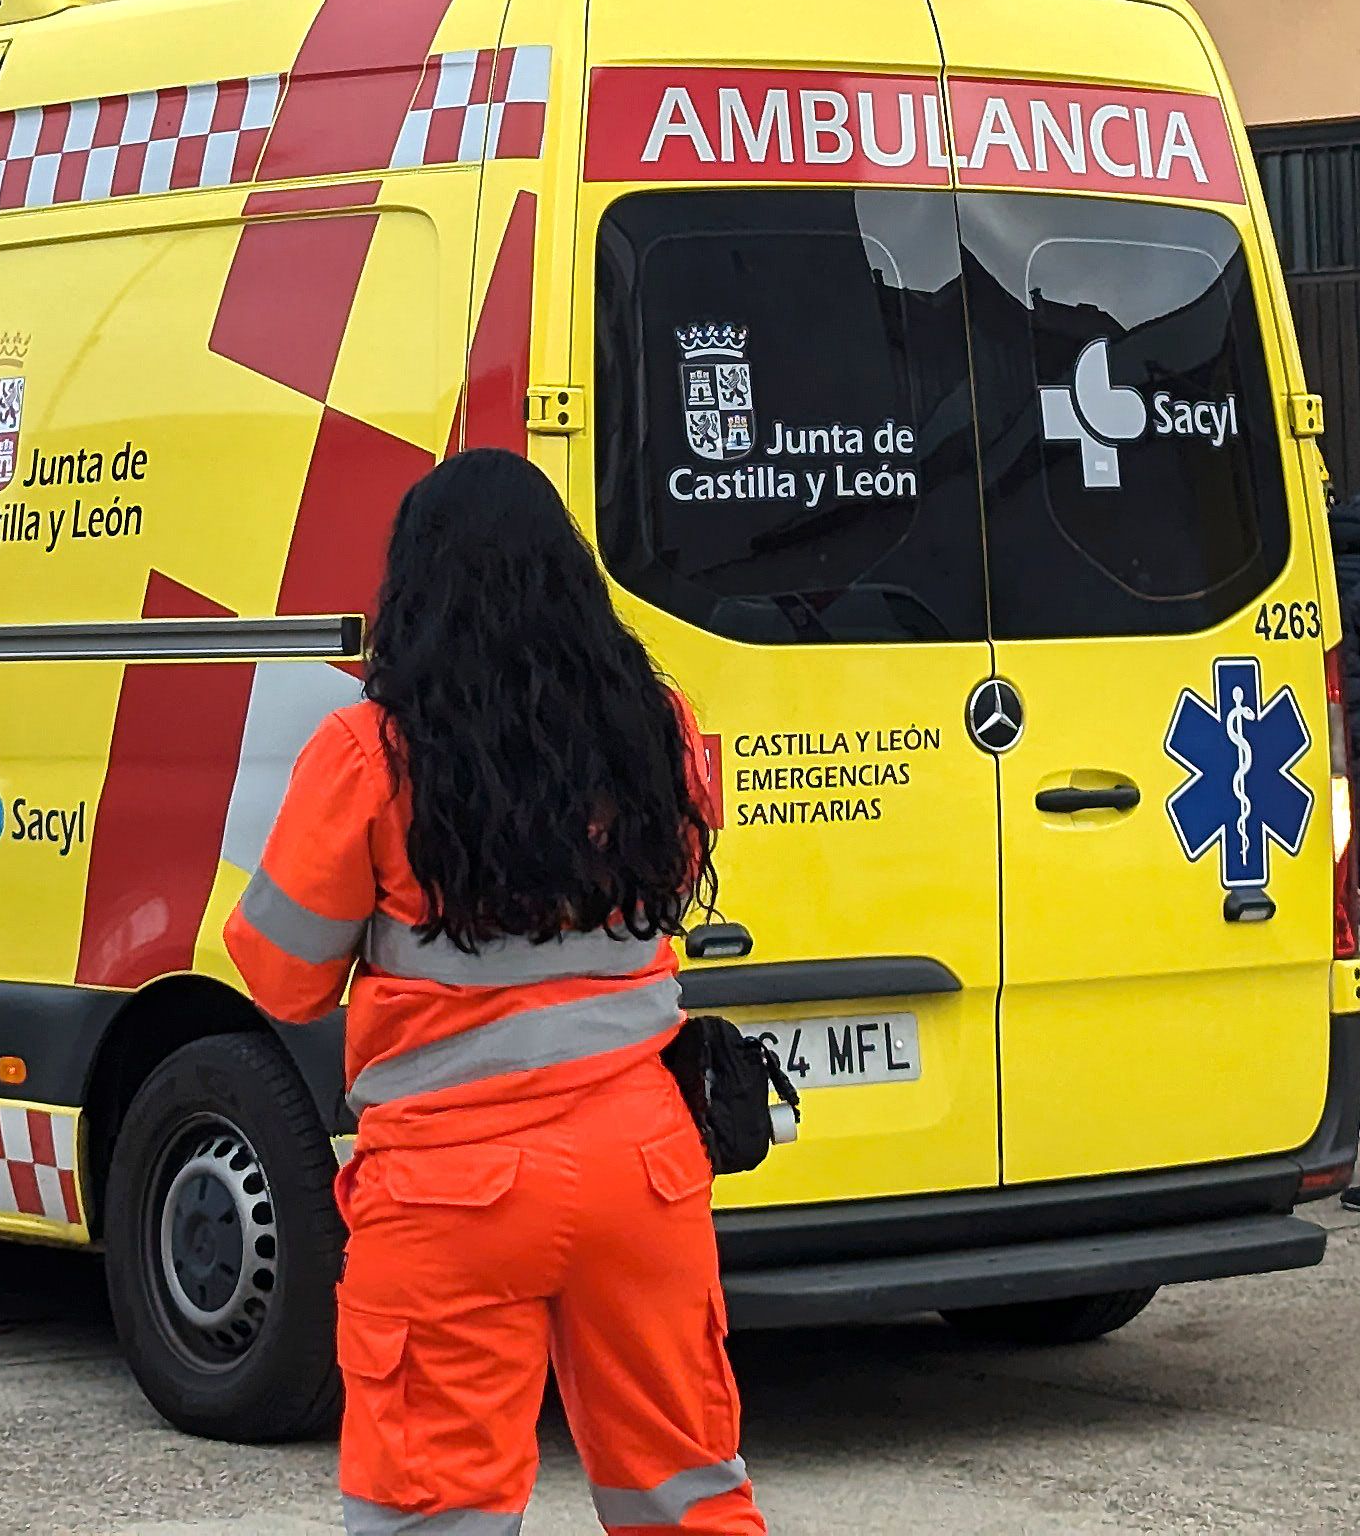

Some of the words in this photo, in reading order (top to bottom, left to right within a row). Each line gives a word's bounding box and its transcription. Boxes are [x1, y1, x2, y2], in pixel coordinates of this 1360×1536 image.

[640, 86, 1210, 184] AMBULANCIA
[766, 422, 864, 455] Junta
[873, 421, 914, 454] de
[1154, 394, 1238, 446] Sacyl
[23, 448, 103, 487] Junta
[112, 441, 148, 481] de
[668, 466, 796, 501] Castilla
[804, 472, 826, 507] y
[836, 463, 917, 496] León
[45, 509, 66, 553] y
[72, 496, 142, 538] León
[1255, 601, 1320, 640] 4263
[735, 733, 850, 757] CASTILLA
[856, 731, 870, 752] Y
[877, 723, 940, 752] LEÓN
[736, 763, 910, 791] EMERGENCIAS
[11, 798, 86, 856] Sacyl
[737, 798, 882, 826] SANITARIAS
[827, 1022, 911, 1076] MFL
